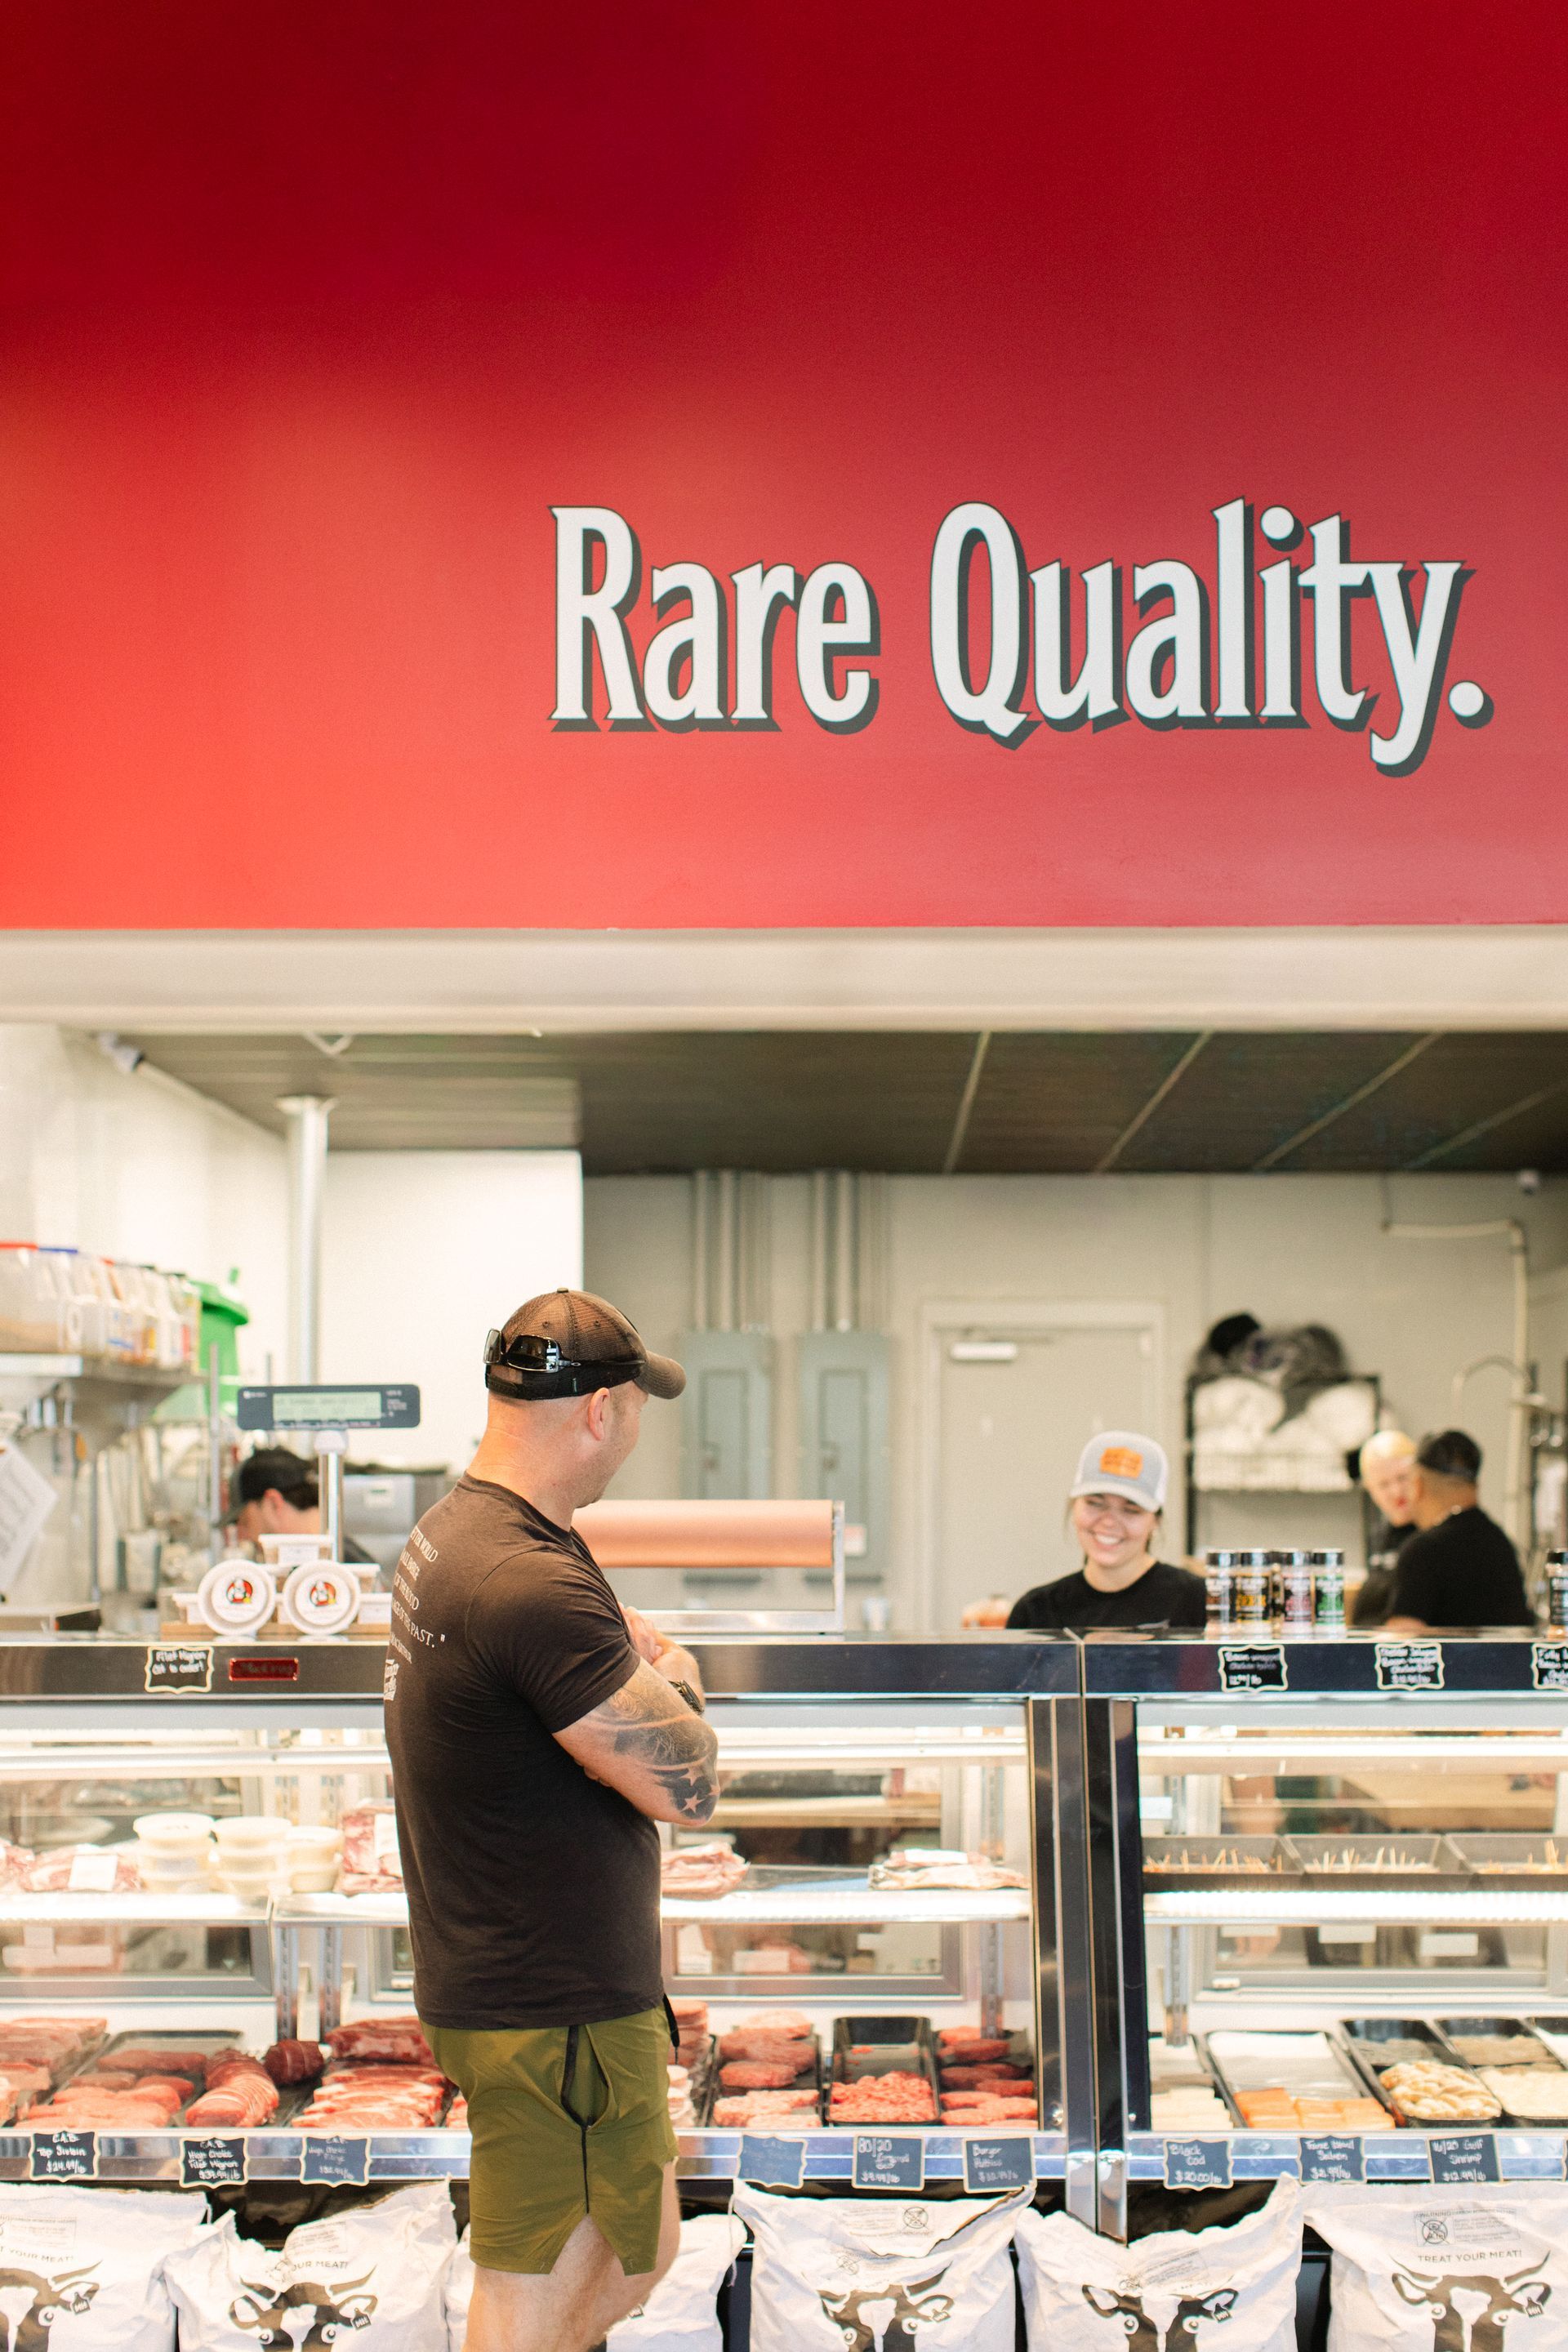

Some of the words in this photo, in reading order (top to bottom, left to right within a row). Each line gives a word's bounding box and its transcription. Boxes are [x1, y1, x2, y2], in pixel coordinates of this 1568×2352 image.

[547, 505, 882, 733] Rare
[928, 495, 1496, 777] Quality.
[410, 1621, 435, 1648] PAST.
[1463, 2138, 1484, 2150] Gulf
[36, 2147, 53, 2158] Top
[972, 2143, 1002, 2158] Burger
[1186, 2154, 1206, 2166] Cod
[1450, 2153, 1482, 2165] Shrimp
[9, 2248, 39, 2259] YOUR
[1417, 2255, 1451, 2264] TREAT
[1456, 2252, 1486, 2262] YOUR
[1489, 2249, 1522, 2259] MEAT!
